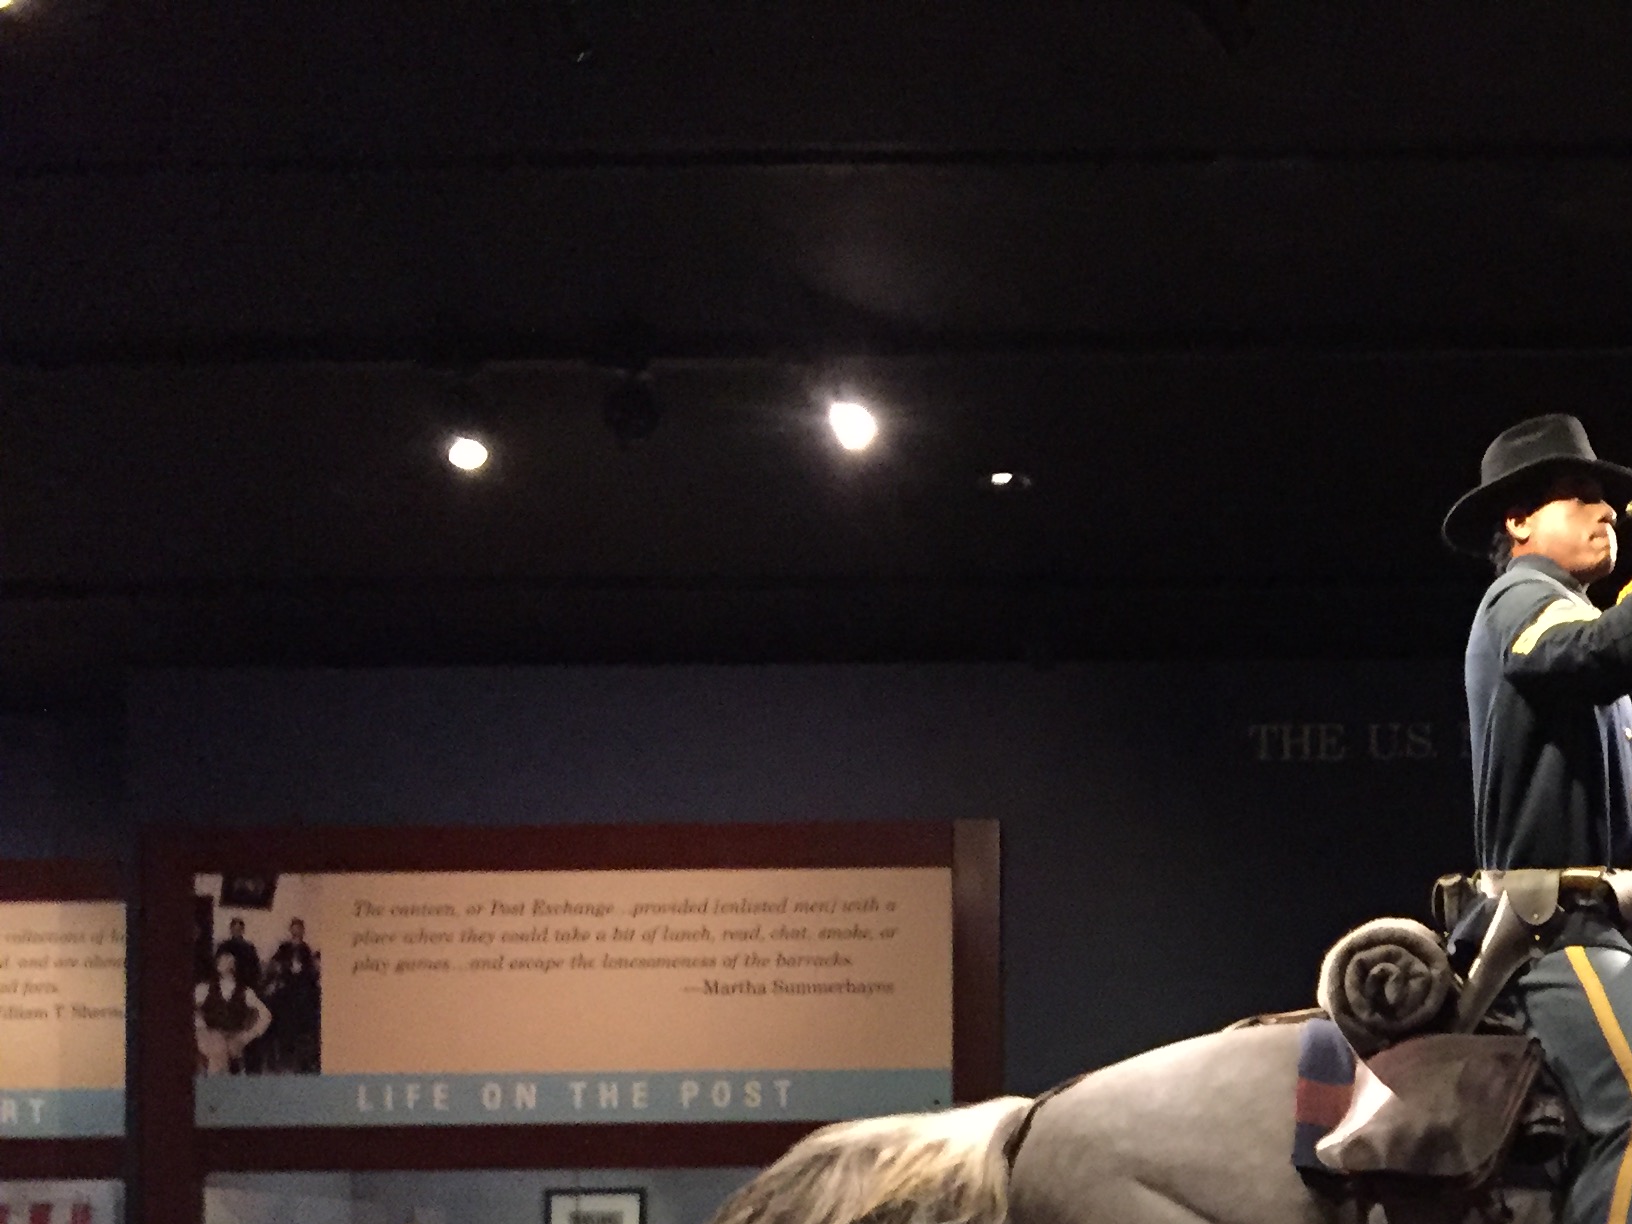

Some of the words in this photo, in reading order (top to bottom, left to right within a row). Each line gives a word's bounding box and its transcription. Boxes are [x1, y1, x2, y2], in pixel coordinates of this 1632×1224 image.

[1250, 721, 1347, 763] THE
[353, 898, 385, 918] The
[465, 903, 484, 917] or
[490, 898, 525, 917] Post
[842, 897, 880, 912] with
[885, 900, 897, 912] a
[351, 929, 397, 948] place
[402, 927, 453, 944] where
[459, 926, 495, 946] they
[501, 926, 549, 943] could
[555, 926, 590, 943] take
[595, 930, 607, 942] a
[612, 925, 636, 942] bit
[640, 925, 661, 946] of
[879, 927, 898, 940] or
[352, 954, 390, 976] play
[509, 957, 565, 974] escape
[569, 953, 595, 970] the
[602, 952, 717, 970] lonesomeness
[722, 953, 741, 971] of
[744, 951, 771, 968] the
[771, 977, 896, 999] Summerhayes
[357, 1083, 450, 1114] LIFE
[480, 1081, 537, 1112] ON
[569, 1079, 650, 1111] THE
[680, 1078, 792, 1109] POST
